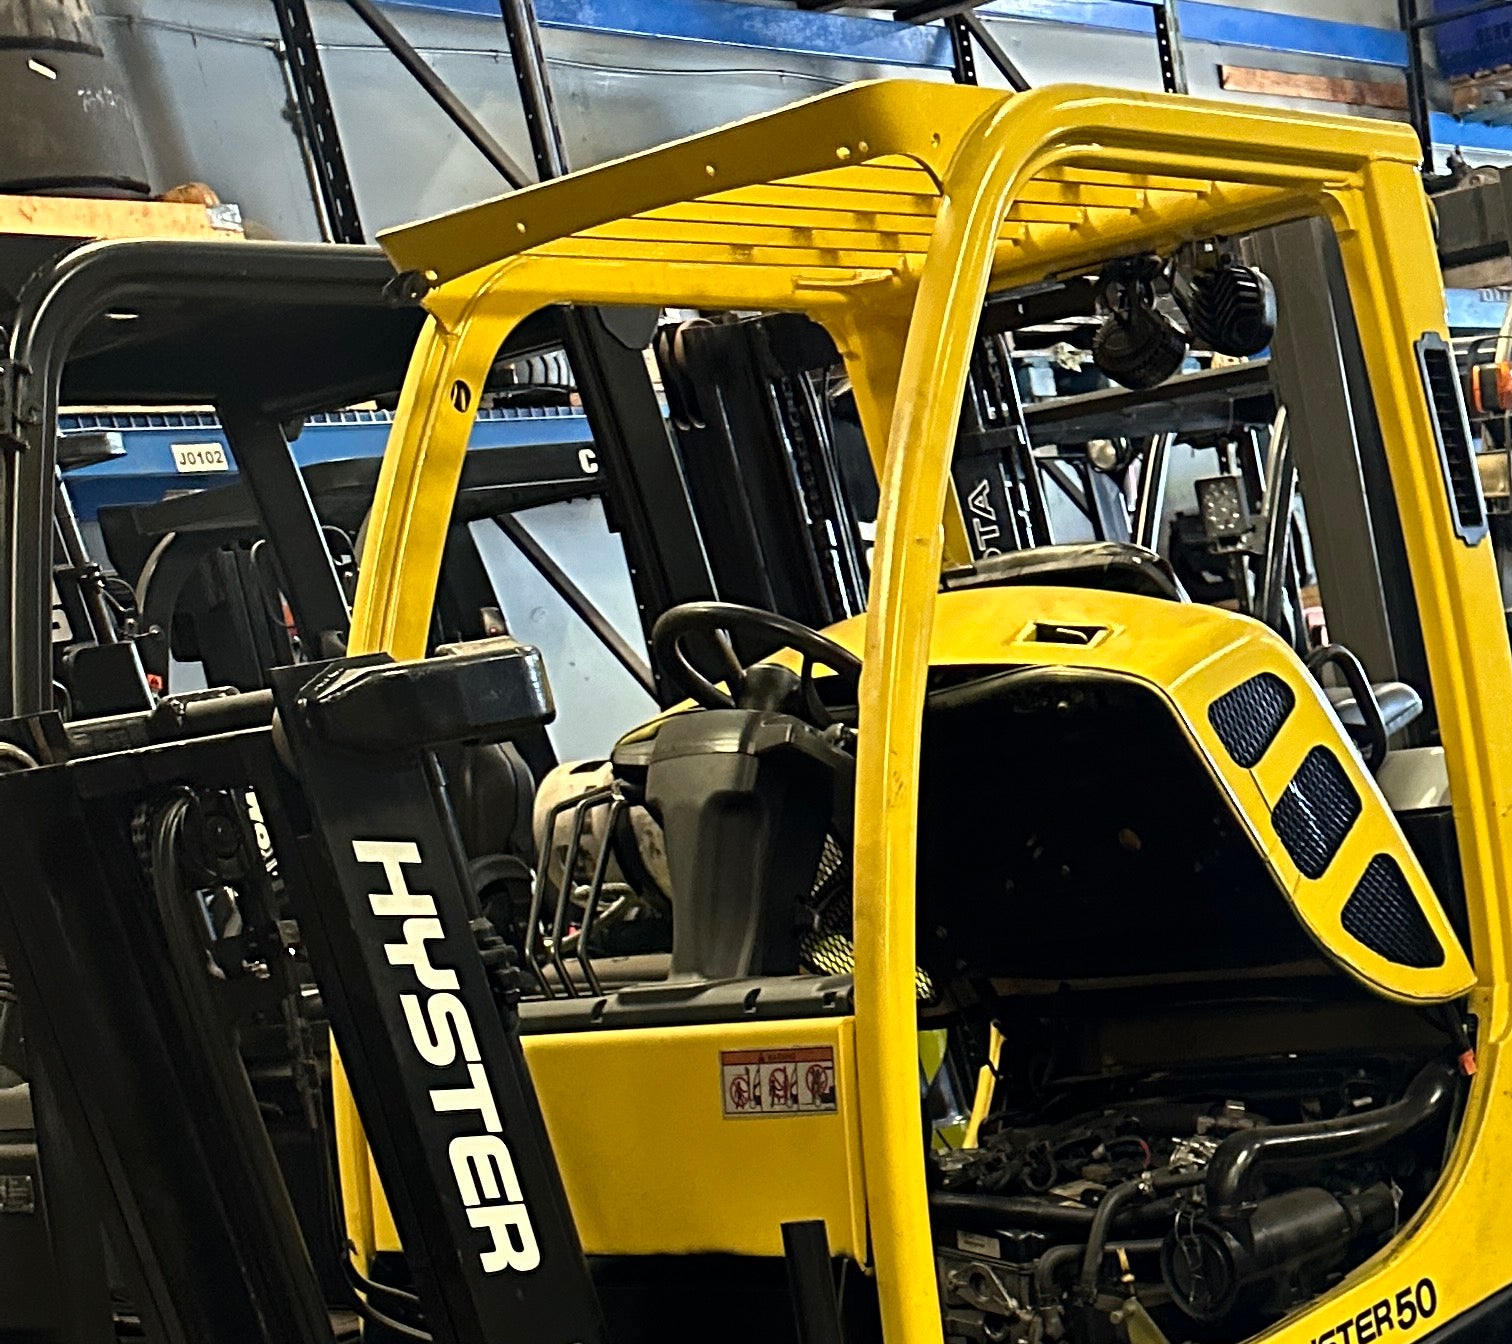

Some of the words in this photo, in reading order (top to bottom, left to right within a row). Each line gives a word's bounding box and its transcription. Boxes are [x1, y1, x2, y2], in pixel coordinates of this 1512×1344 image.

[179, 450, 224, 466] J0102
[967, 478, 1002, 559] TA
[351, 839, 541, 1274] HYSTER
